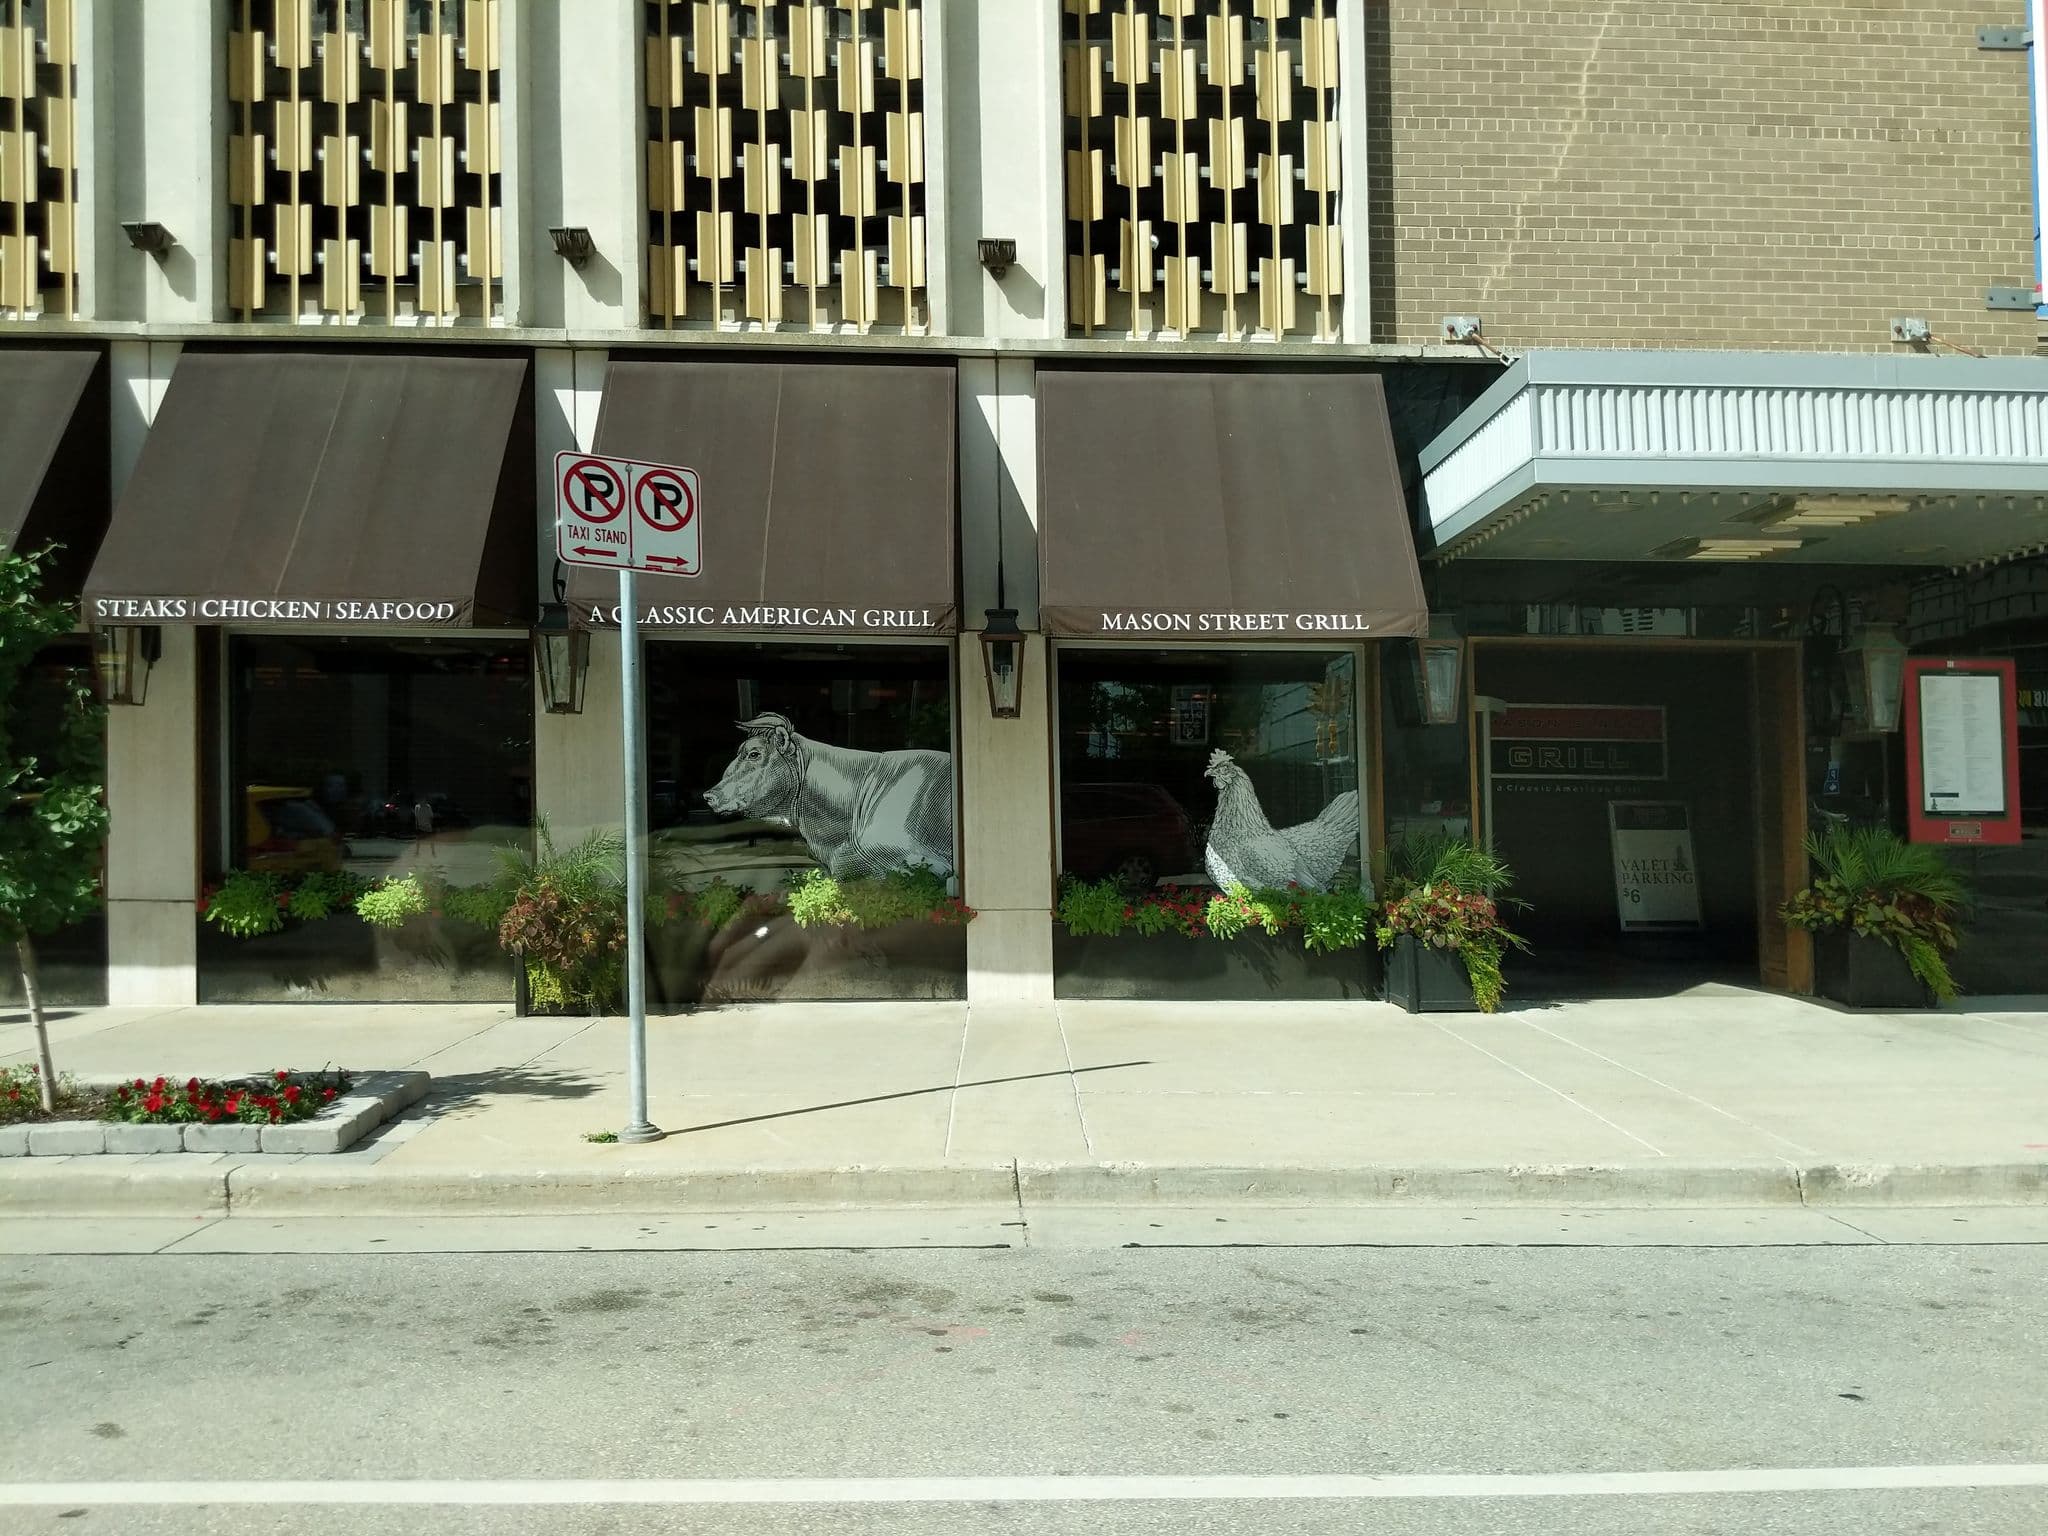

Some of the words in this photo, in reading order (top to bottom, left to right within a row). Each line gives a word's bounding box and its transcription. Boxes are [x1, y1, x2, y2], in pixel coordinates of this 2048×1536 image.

[567, 525, 590, 541] TAXI
[594, 528, 627, 545] STAND
[97, 599, 187, 617] STEAKS
[202, 600, 321, 619] CHICKEN
[335, 601, 454, 620] SEAFOOD
[589, 605, 606, 623] A
[721, 606, 857, 626] AMERICAN
[863, 609, 936, 627] GRILL
[1101, 613, 1192, 631] MASON
[1198, 614, 1289, 631] STREET
[1295, 613, 1370, 631] GRILL
[1508, 746, 1631, 769] GRILL
[1621, 859, 1668, 871] VALET
[1622, 872, 1694, 885] PARKING
[1623, 888, 1641, 904] $6
